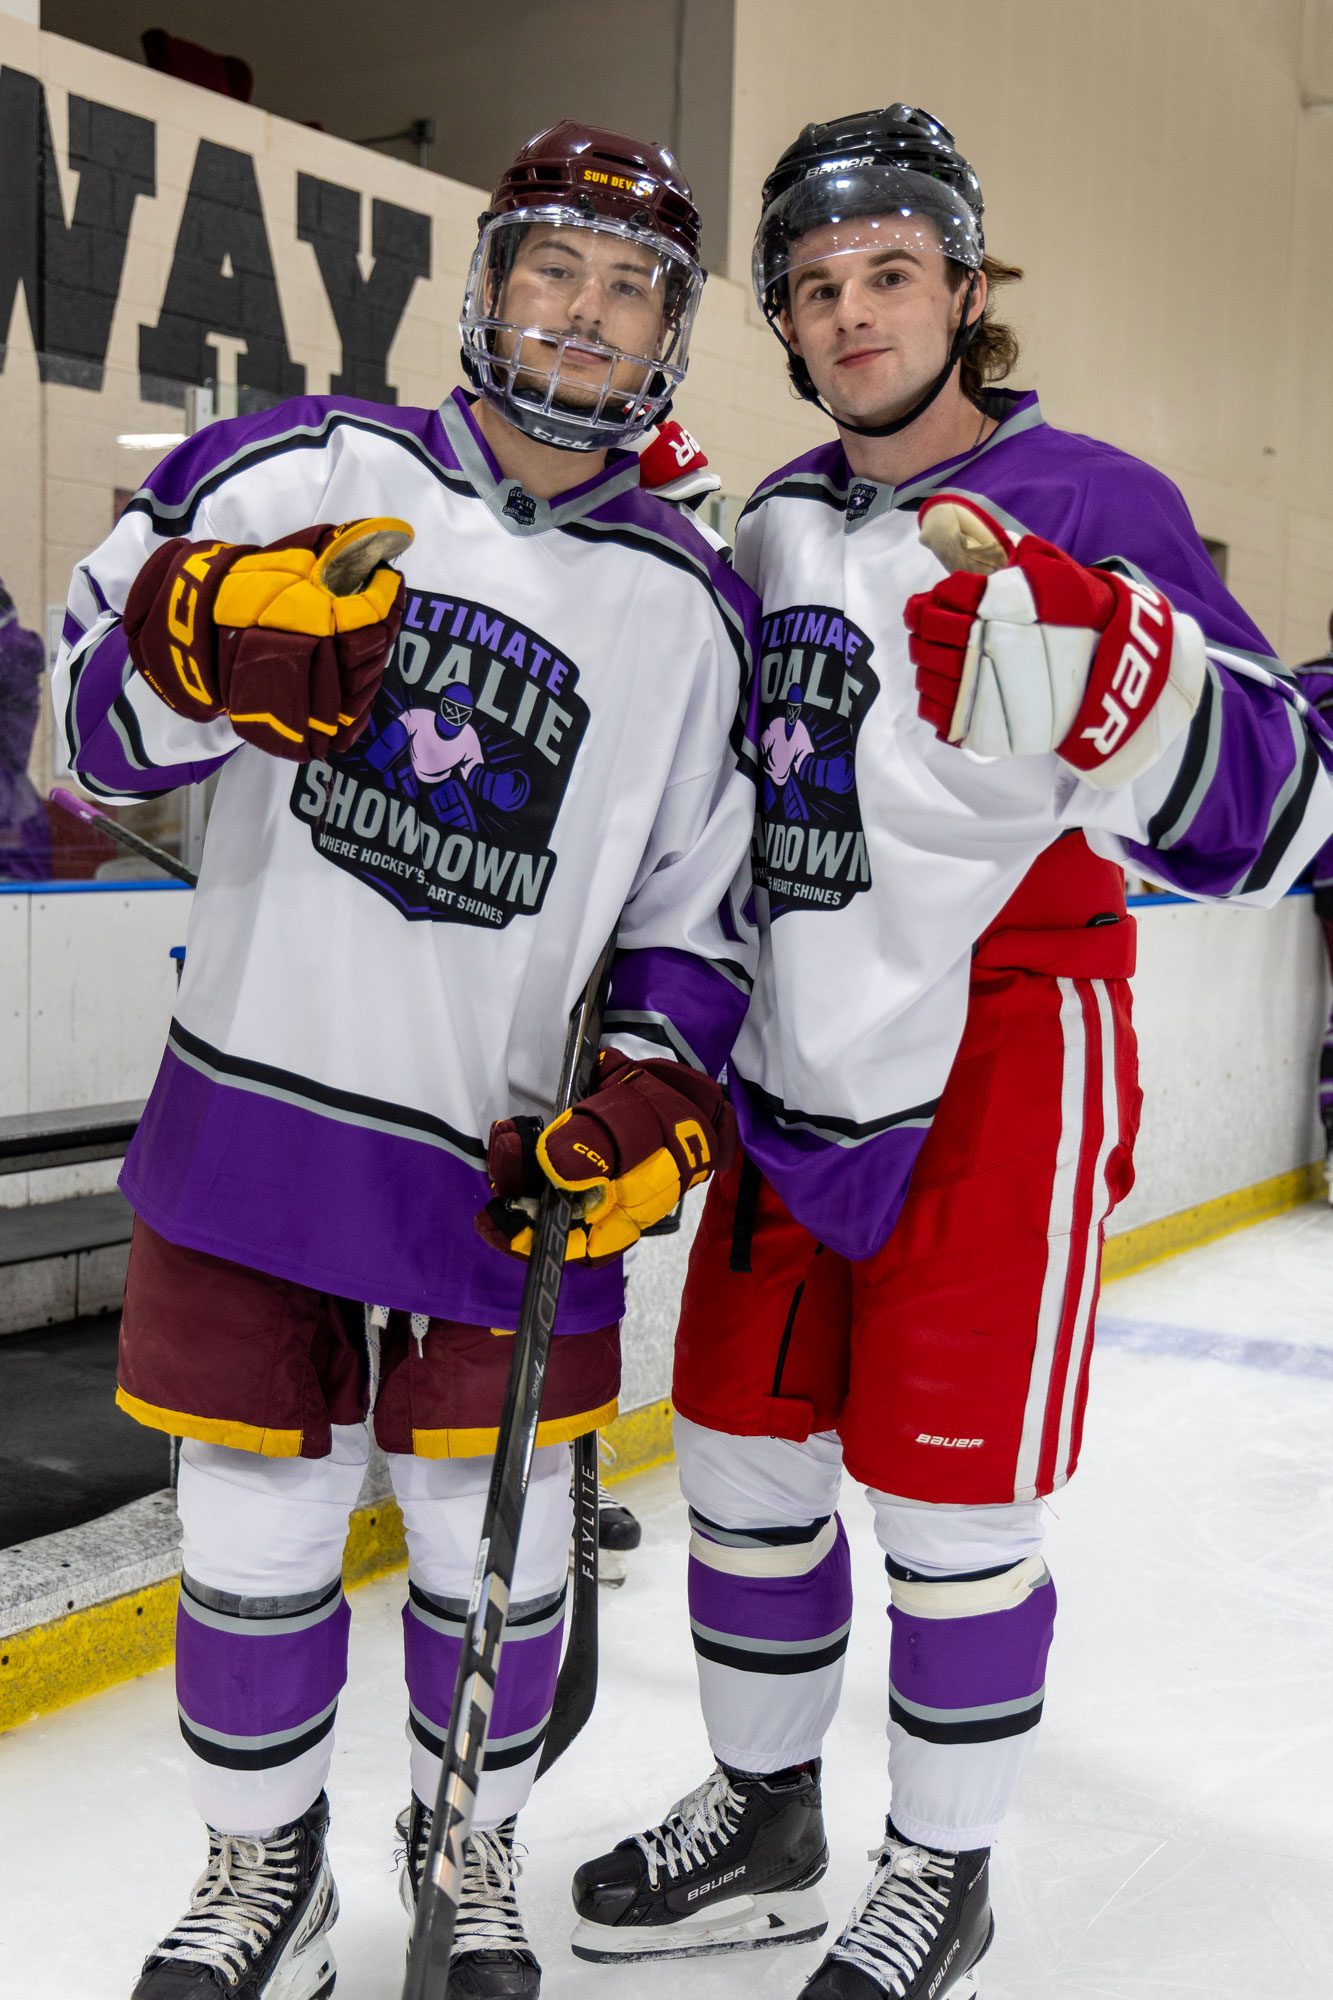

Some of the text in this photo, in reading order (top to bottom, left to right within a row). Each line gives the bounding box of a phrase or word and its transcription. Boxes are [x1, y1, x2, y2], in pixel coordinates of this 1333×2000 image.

[583, 170, 608, 184] SUN
[532, 427, 593, 450] CCM
[404, 596, 569, 697] LTIMATE
[1080, 571, 1164, 756] AUER
[385, 630, 574, 767] OALIE
[319, 832, 357, 860] WHERE
[457, 894, 504, 925] SHINES
[793, 883, 842, 906] SHINES
[572, 1142, 610, 1173] CCM
[582, 1465, 595, 1582] FLYLITE
